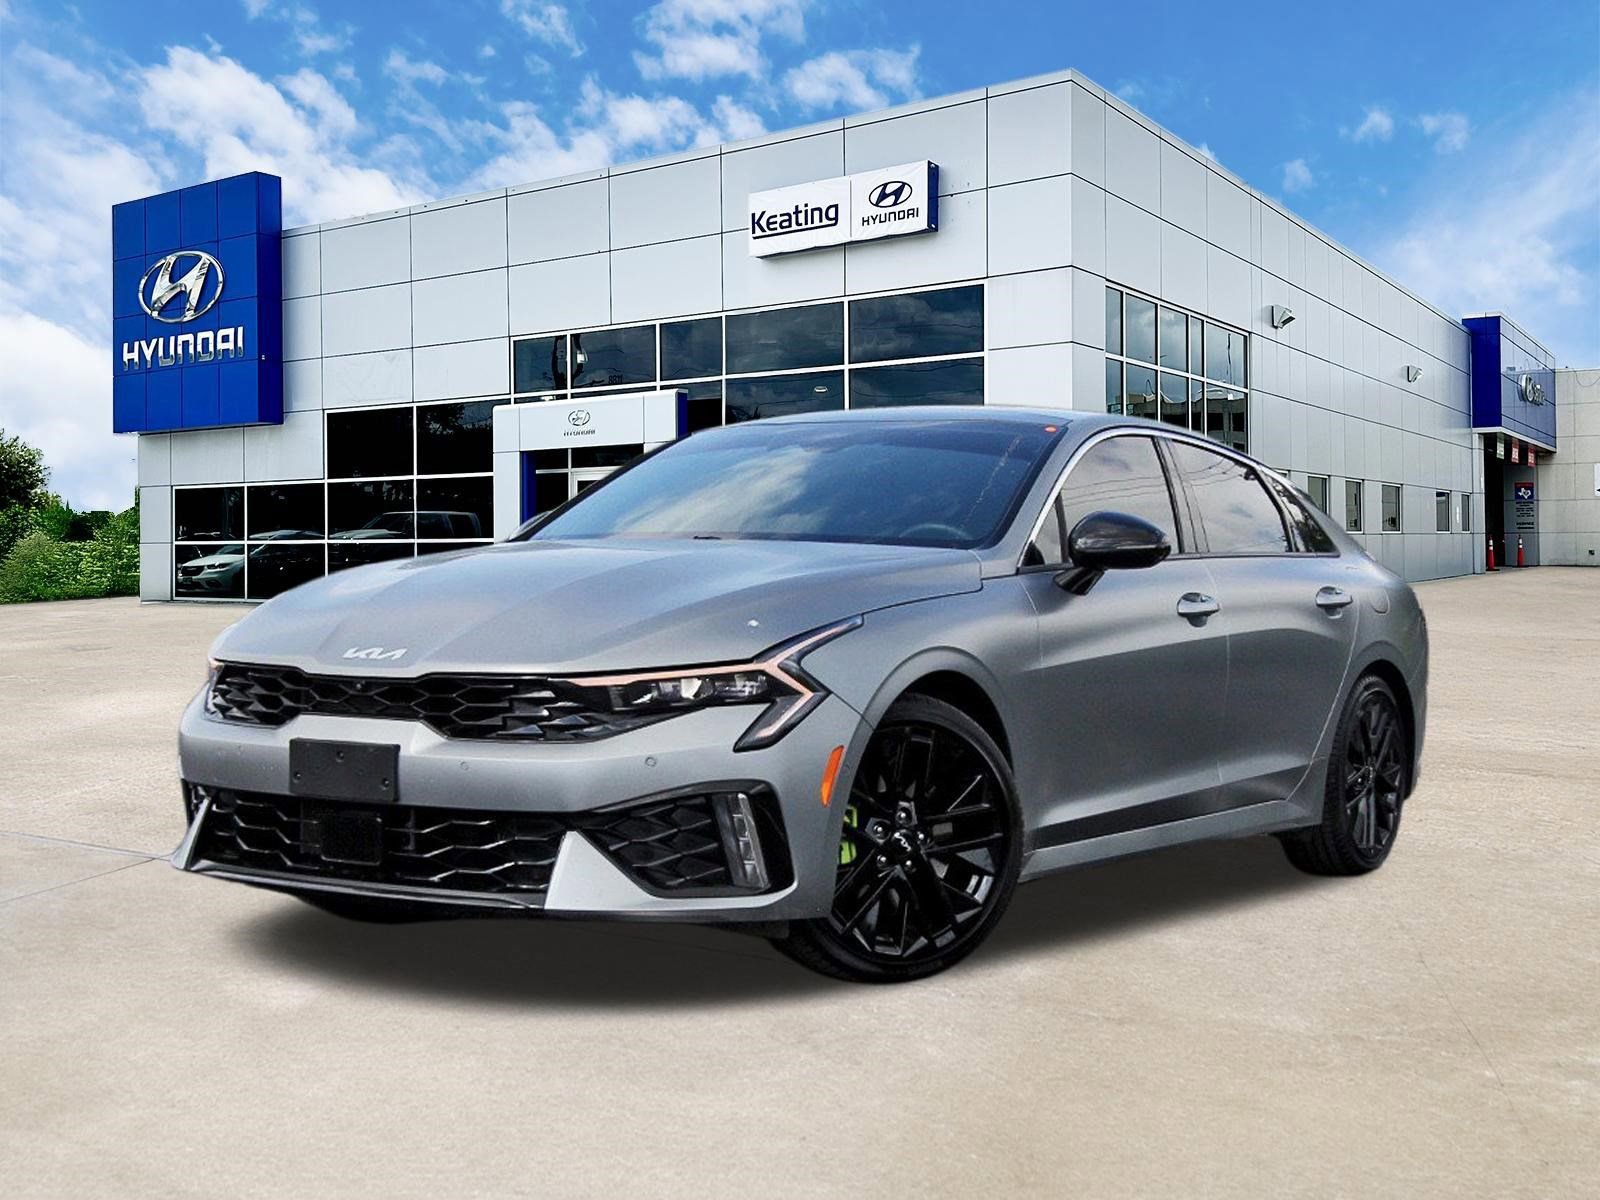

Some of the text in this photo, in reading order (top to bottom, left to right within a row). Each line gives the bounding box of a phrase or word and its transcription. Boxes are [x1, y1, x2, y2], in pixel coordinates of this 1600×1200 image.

[751, 203, 839, 239] Keating
[861, 207, 919, 226] HYUNDAI
[122, 326, 244, 371] HYUNDAI
[343, 647, 407, 660] KIA
